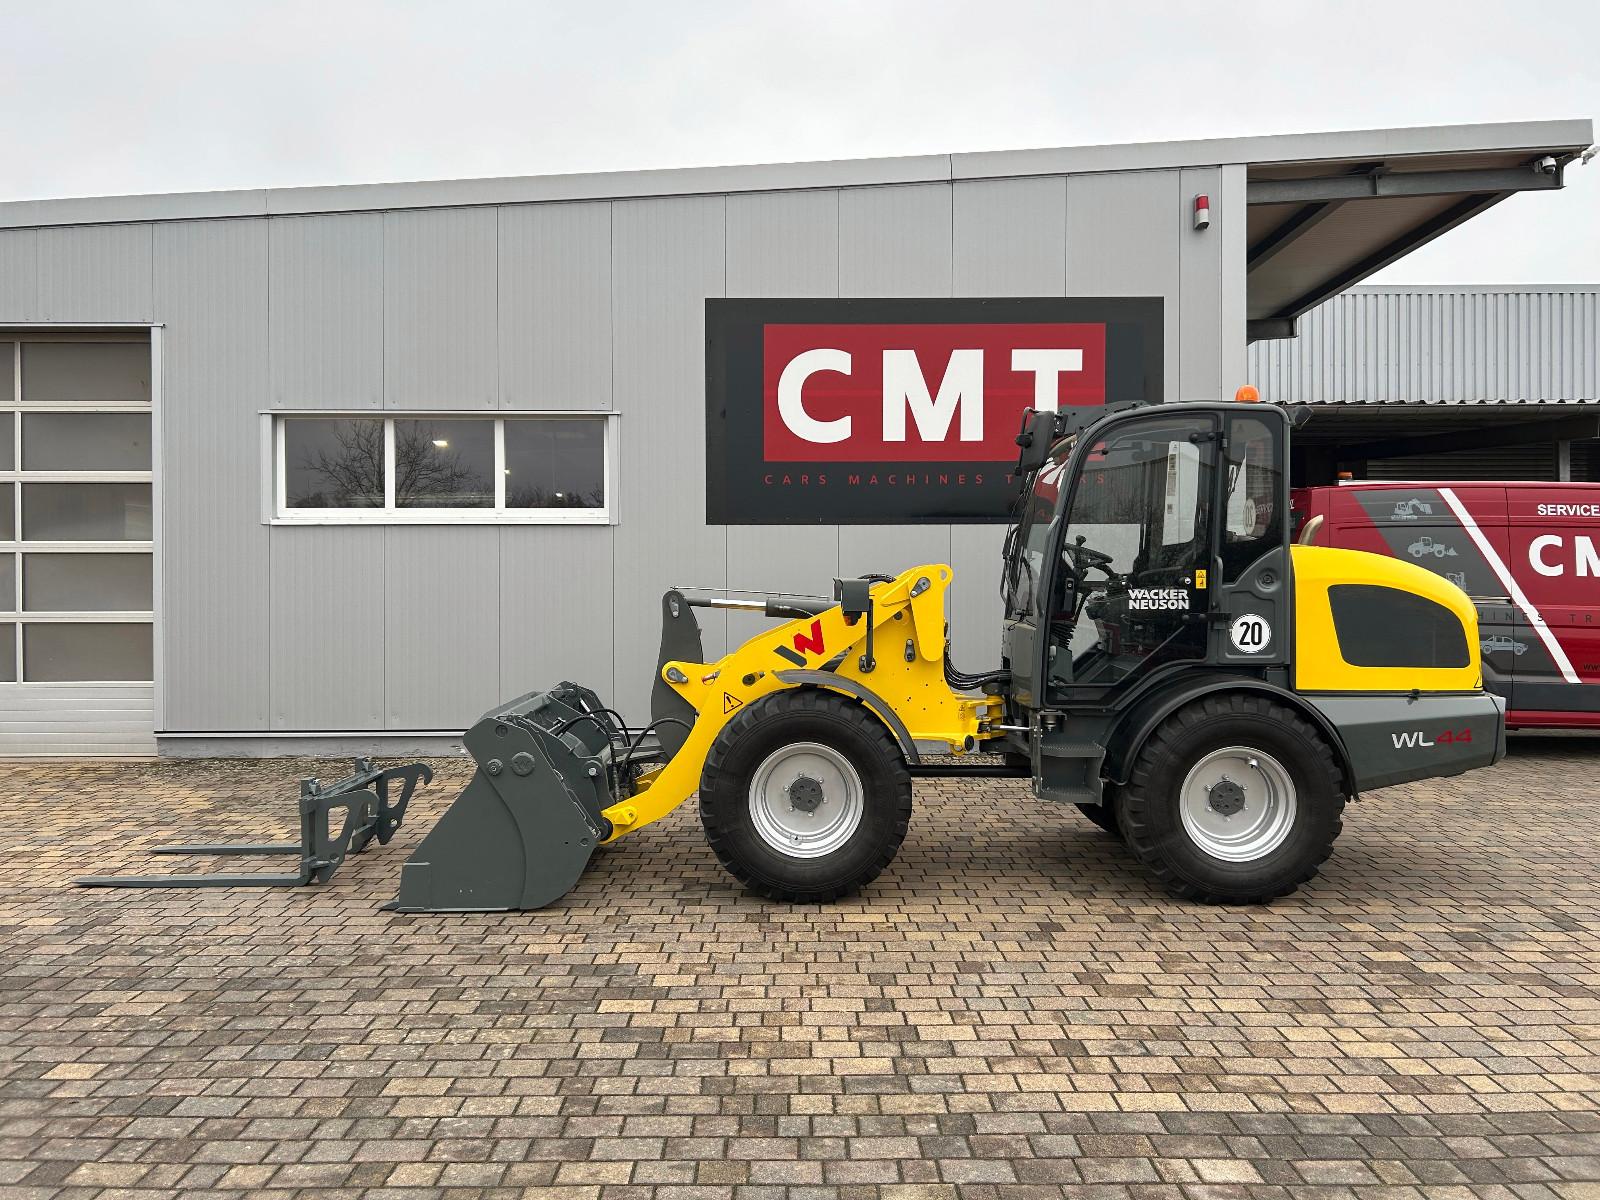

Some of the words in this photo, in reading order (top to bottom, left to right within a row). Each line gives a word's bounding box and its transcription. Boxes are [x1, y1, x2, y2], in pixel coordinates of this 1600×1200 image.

[777, 348, 1084, 444] CMT
[764, 474, 828, 485] CARS
[849, 474, 984, 485] MACHINES
[1537, 503, 1600, 517] SERVICE
[1128, 588, 1189, 600] WACKER
[1128, 600, 1189, 610] NEUSON
[1239, 621, 1263, 647] 20
